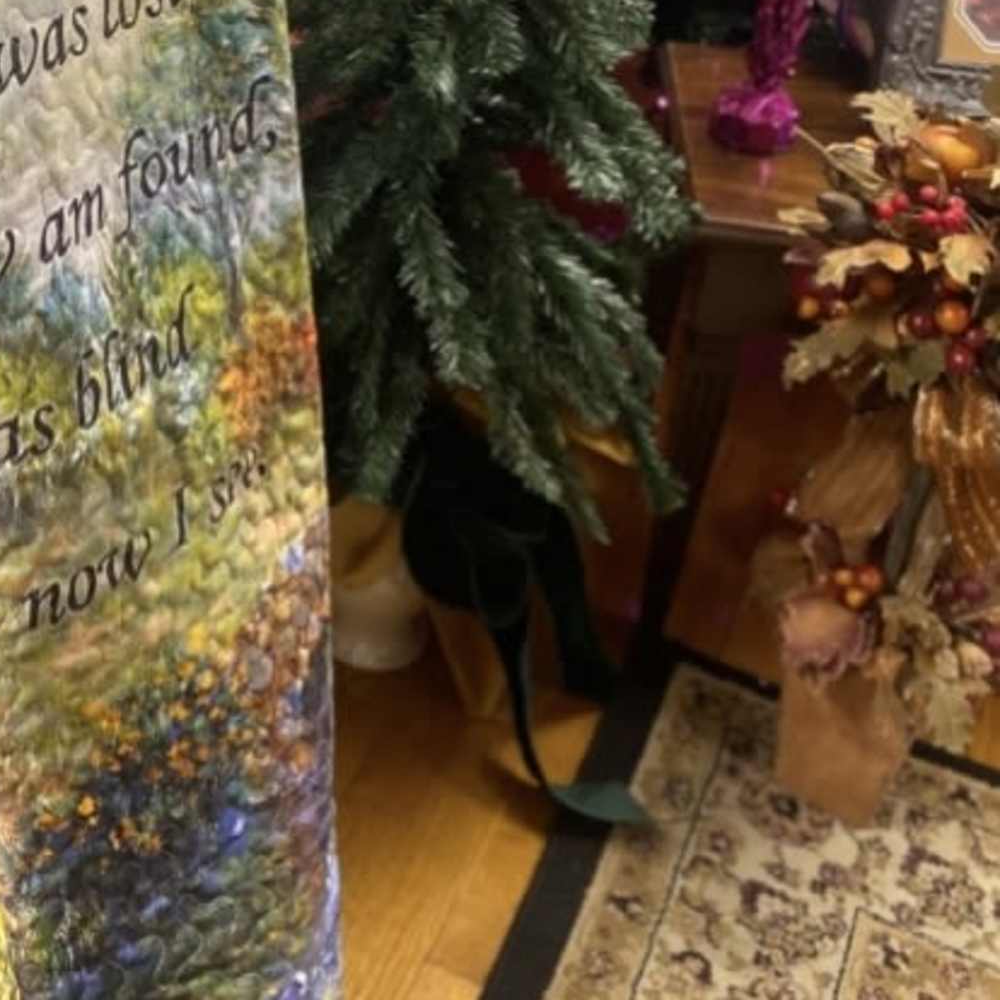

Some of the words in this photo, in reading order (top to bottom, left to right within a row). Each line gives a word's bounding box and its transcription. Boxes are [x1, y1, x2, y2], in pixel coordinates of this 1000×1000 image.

[40, 185, 104, 263] am
[114, 75, 278, 242] found,
[75, 282, 195, 430] blind
[26, 529, 150, 630] now
